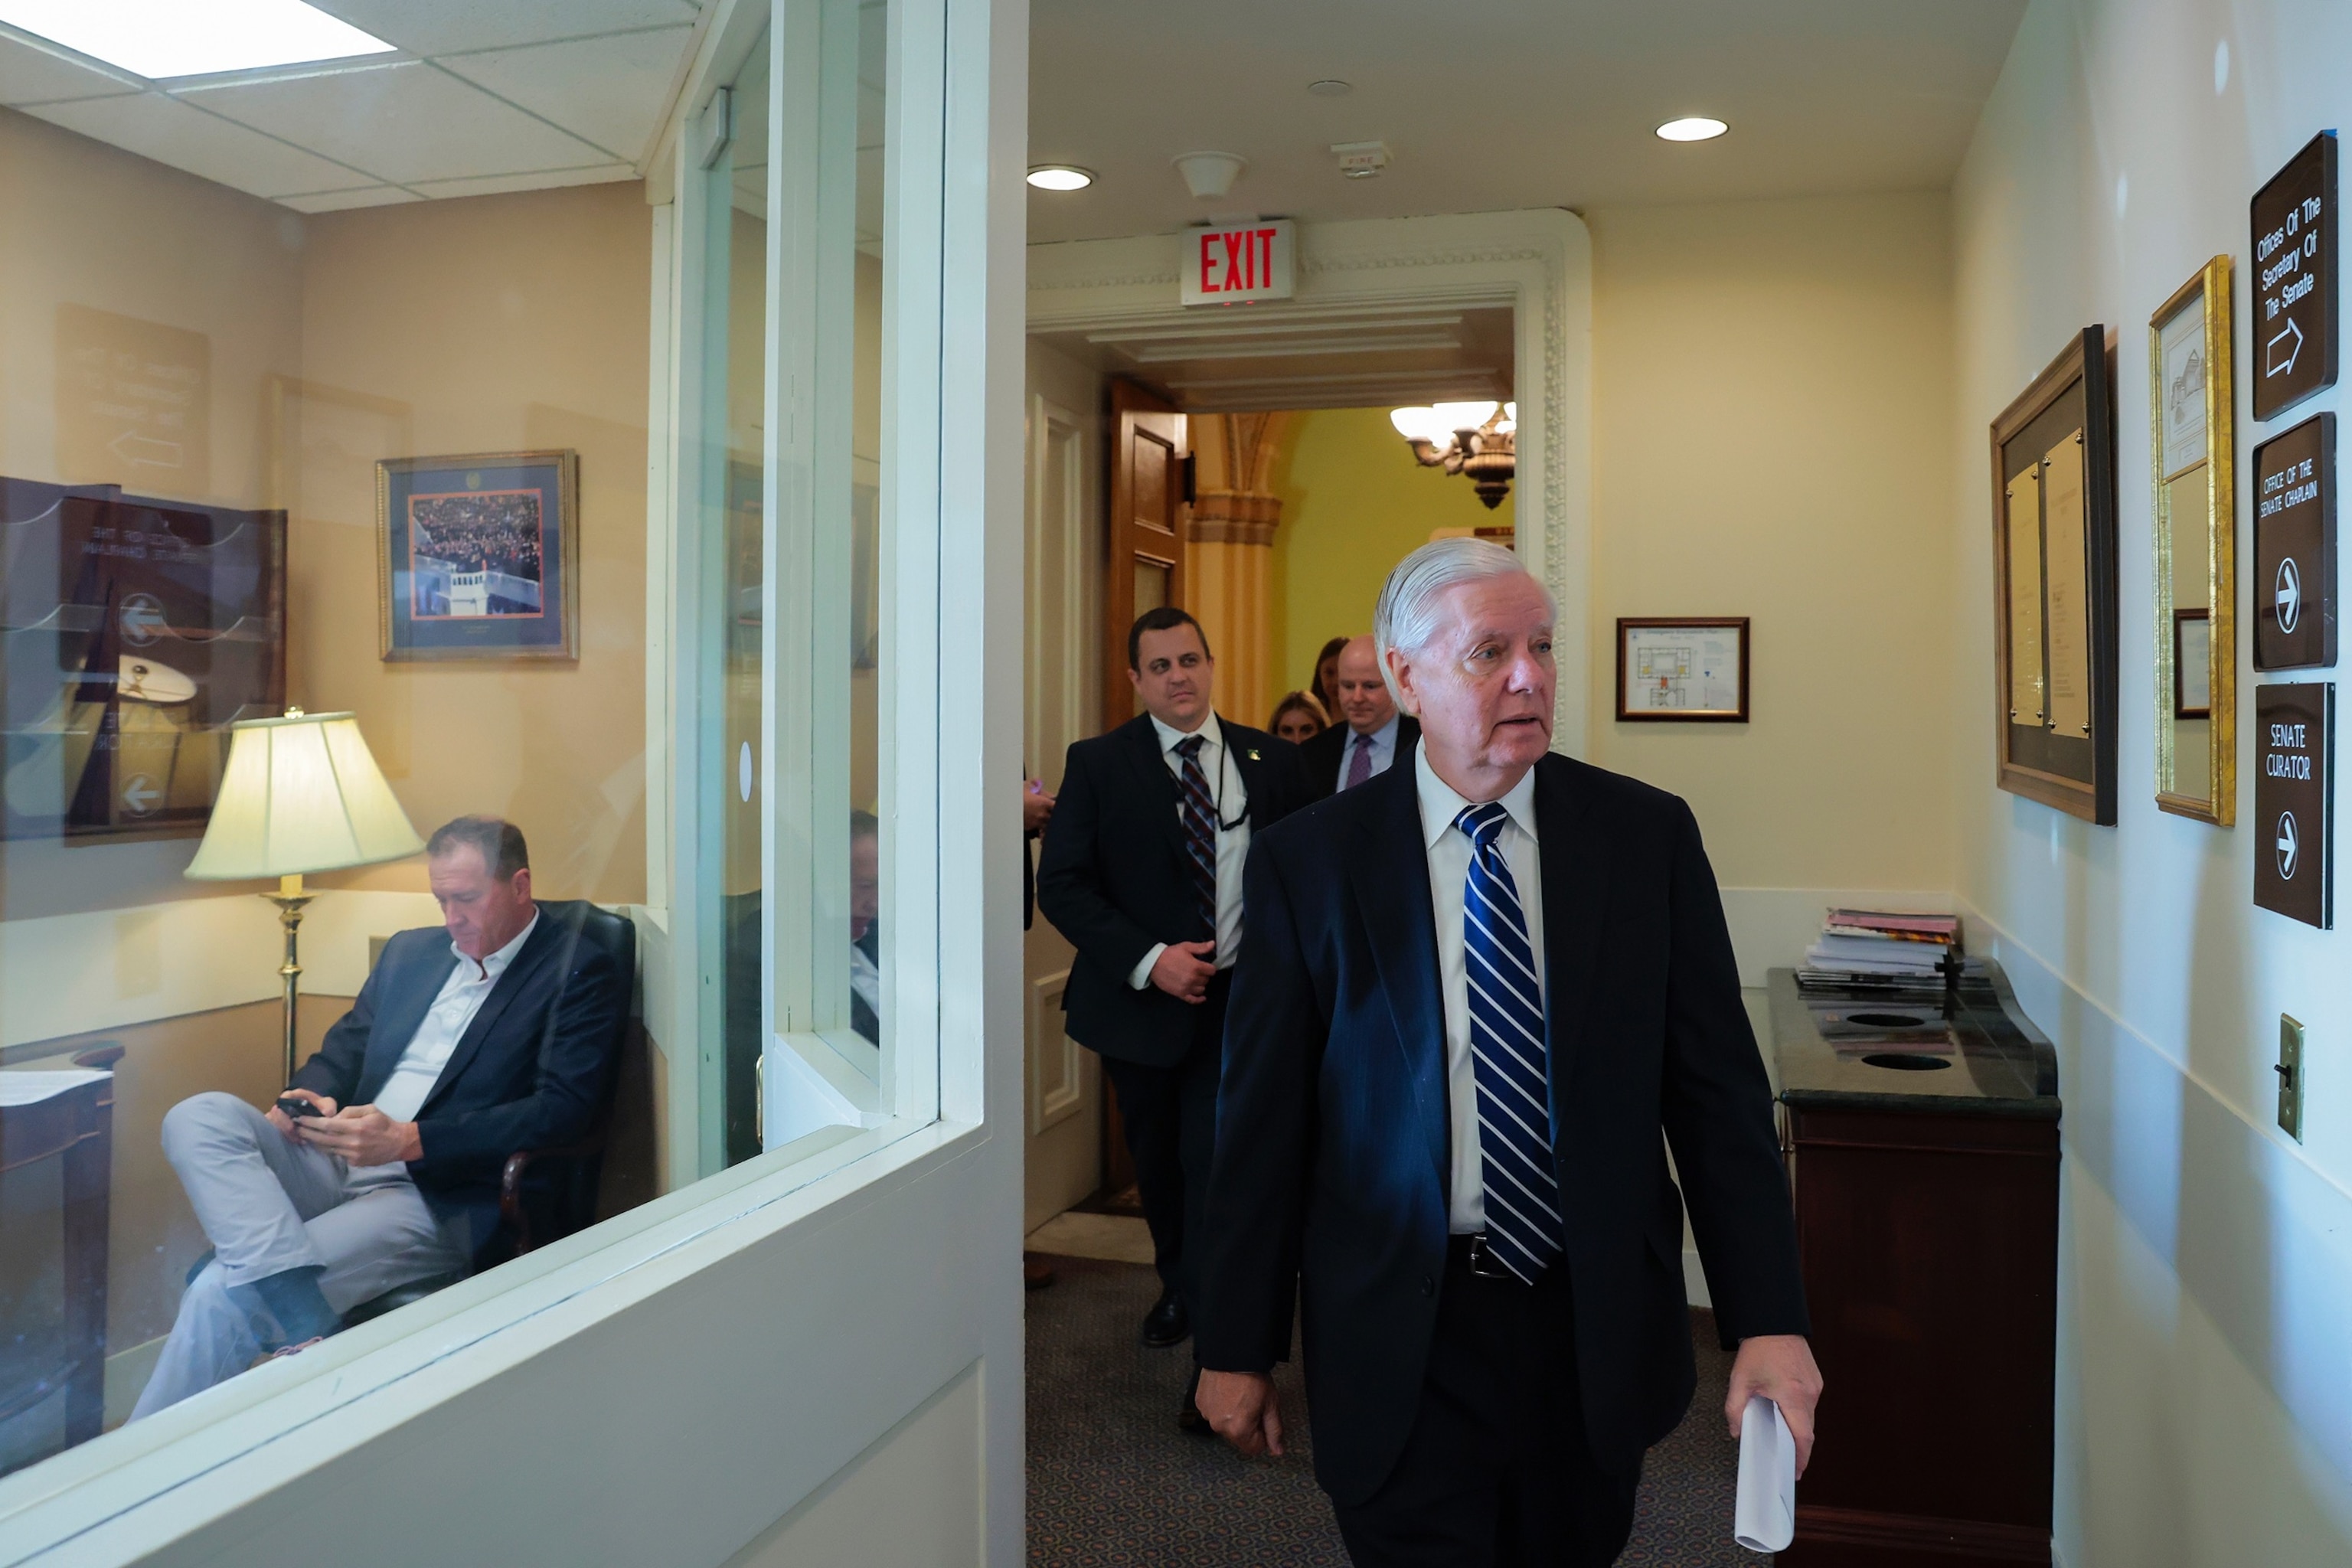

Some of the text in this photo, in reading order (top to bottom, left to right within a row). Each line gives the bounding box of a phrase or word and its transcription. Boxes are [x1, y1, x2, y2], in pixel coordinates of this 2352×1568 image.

[2257, 196, 2321, 262] Offices Of The
[1200, 228, 1276, 292] EXIT
[2262, 229, 2317, 291] Secretary Of
[2265, 273, 2314, 321] The Senate
[2264, 458, 2312, 495] OFFICE OF THE
[2260, 479, 2318, 518] SENATE CHAPLAIN
[2271, 724, 2305, 748] SENATE
[2266, 753, 2311, 780] CURATOR
